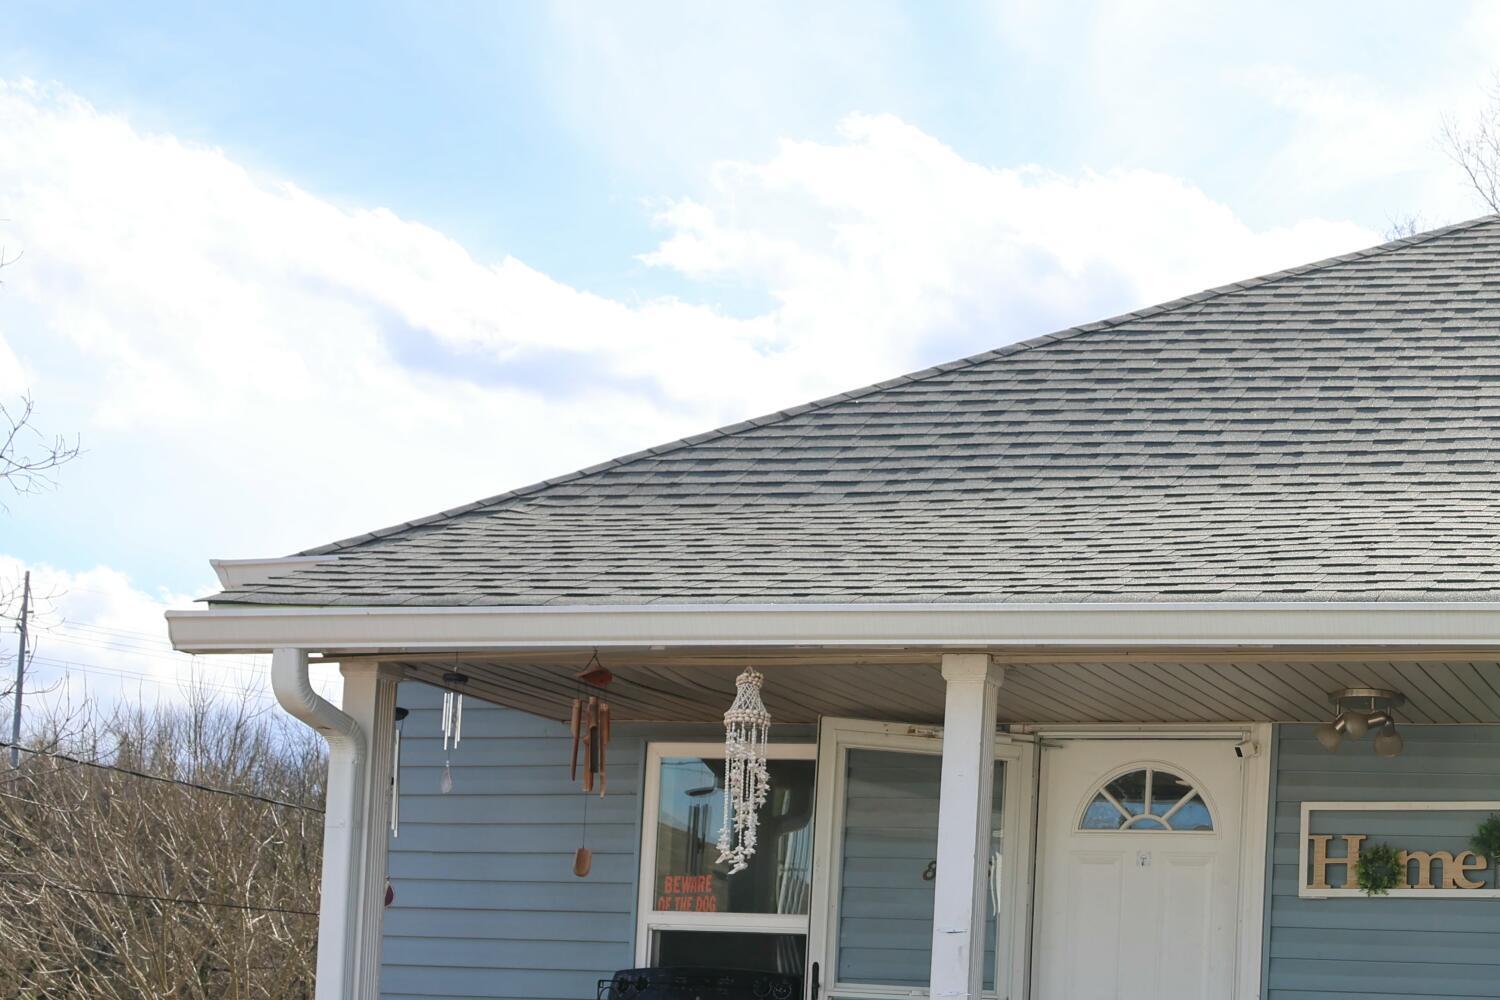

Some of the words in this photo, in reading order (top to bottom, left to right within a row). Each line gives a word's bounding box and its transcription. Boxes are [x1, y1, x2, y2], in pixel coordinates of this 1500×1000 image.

[664, 874, 713, 893] BEWARE
[658, 896, 672, 912] OF
[675, 896, 692, 912] THE
[696, 896, 718, 912] DOG
